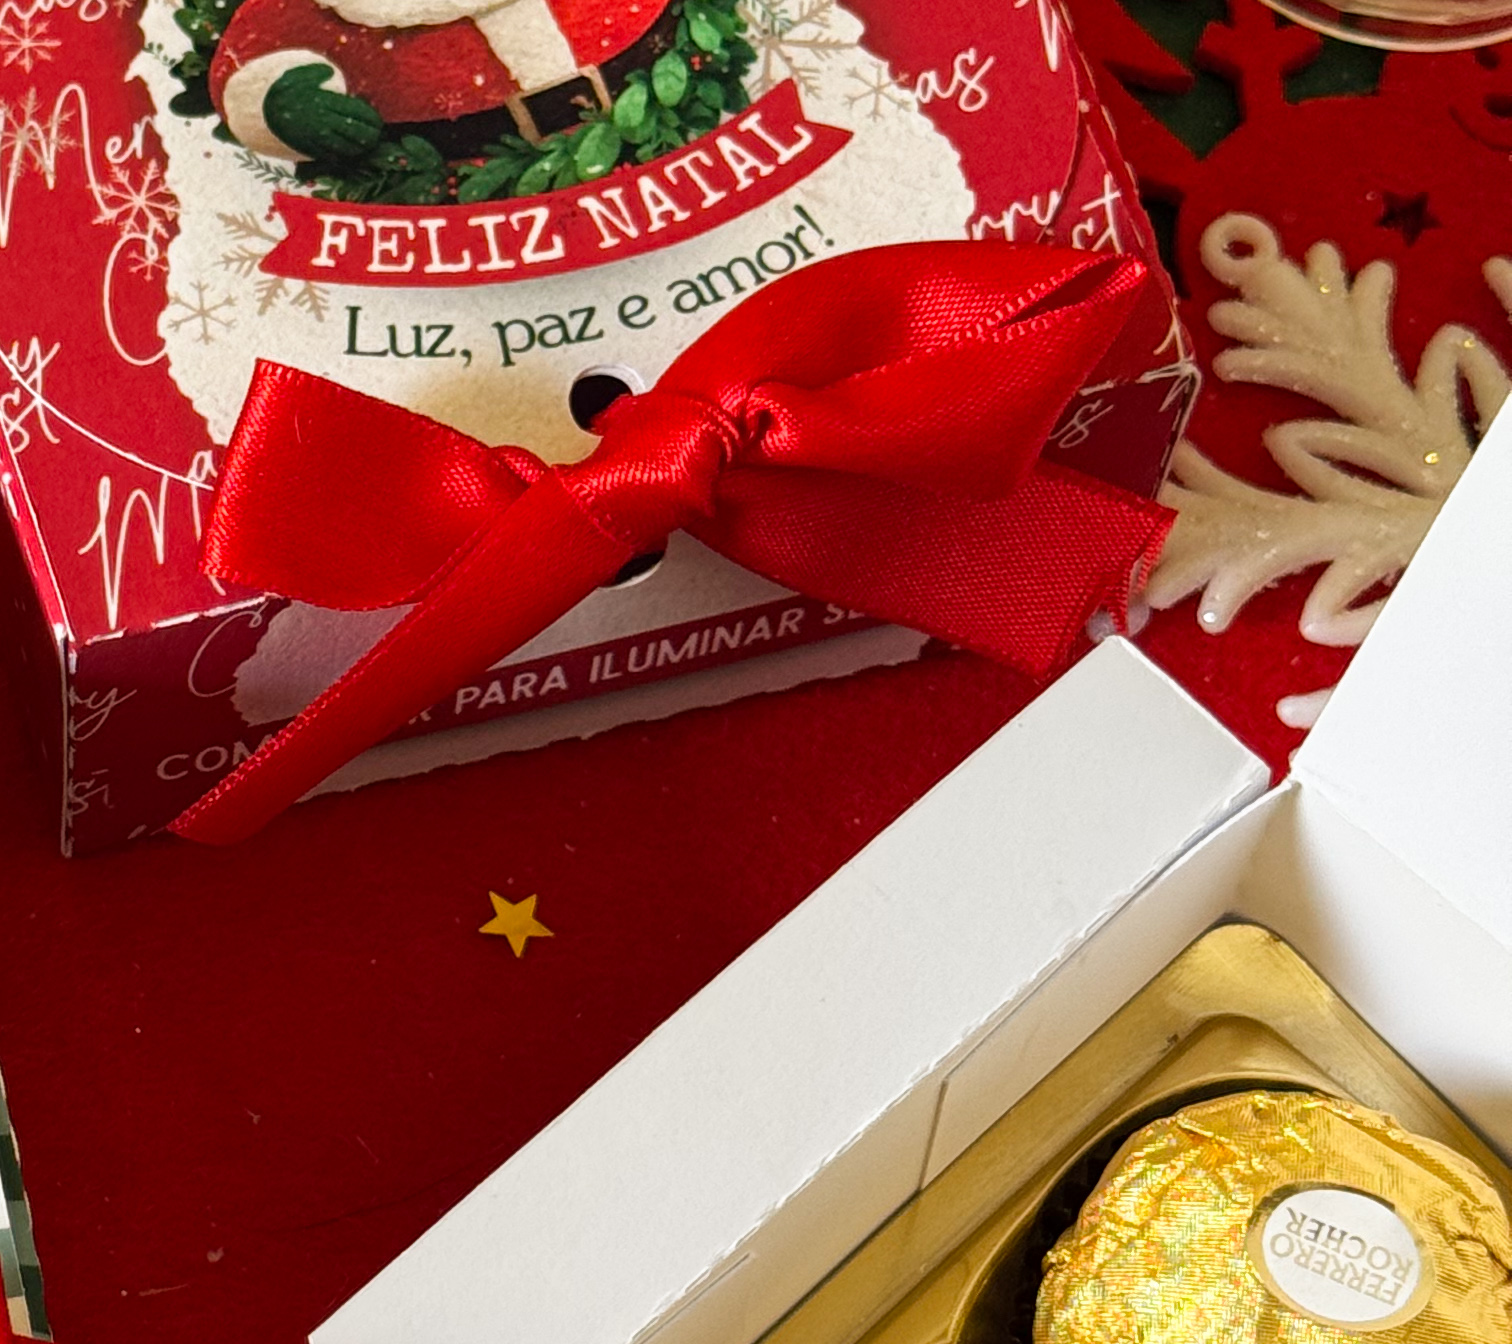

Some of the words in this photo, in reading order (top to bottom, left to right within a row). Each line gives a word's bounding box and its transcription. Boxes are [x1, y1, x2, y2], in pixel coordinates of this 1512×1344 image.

[310, 206, 565, 275] FELIZ
[577, 111, 814, 250] NATAL
[343, 305, 473, 366] Luz,
[492, 304, 605, 368] paz
[617, 294, 657, 331] e
[672, 203, 837, 316] amor!
[453, 664, 570, 716] PARA
[589, 606, 806, 684] ILUMINAR
[1270, 1232, 1403, 1307] FERRERO
[1285, 1206, 1414, 1284] ROCHER
